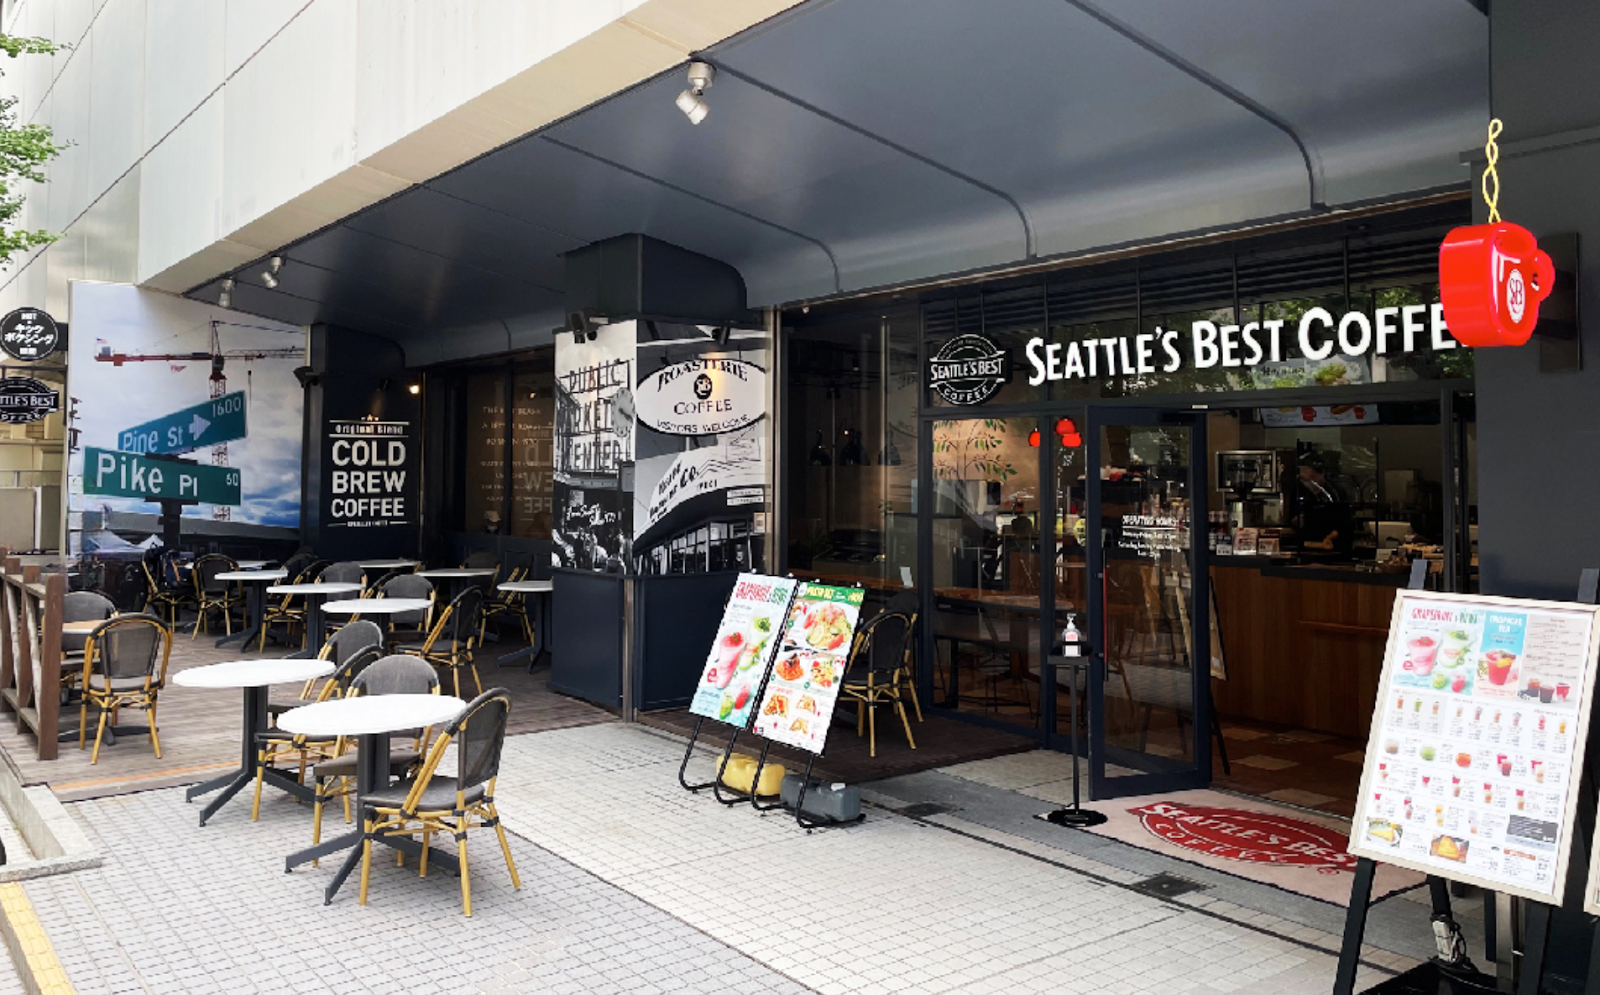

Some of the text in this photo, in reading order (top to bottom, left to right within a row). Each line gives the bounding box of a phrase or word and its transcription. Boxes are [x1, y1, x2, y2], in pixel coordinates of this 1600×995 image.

[1025, 303, 1468, 387] SEATTLE'S BEST COFFE
[930, 358, 1004, 380] SEATTLE'S BEST
[30, 396, 55, 407] BEST
[944, 385, 988, 402] COFFEE
[673, 399, 732, 415] COFFEE
[123, 396, 241, 454] Pine St 1600
[332, 440, 406, 467] COLD
[96, 452, 164, 494] Pike
[179, 474, 198, 497] Pl
[332, 471, 406, 494] BREW
[331, 498, 405, 518] COFFEE
